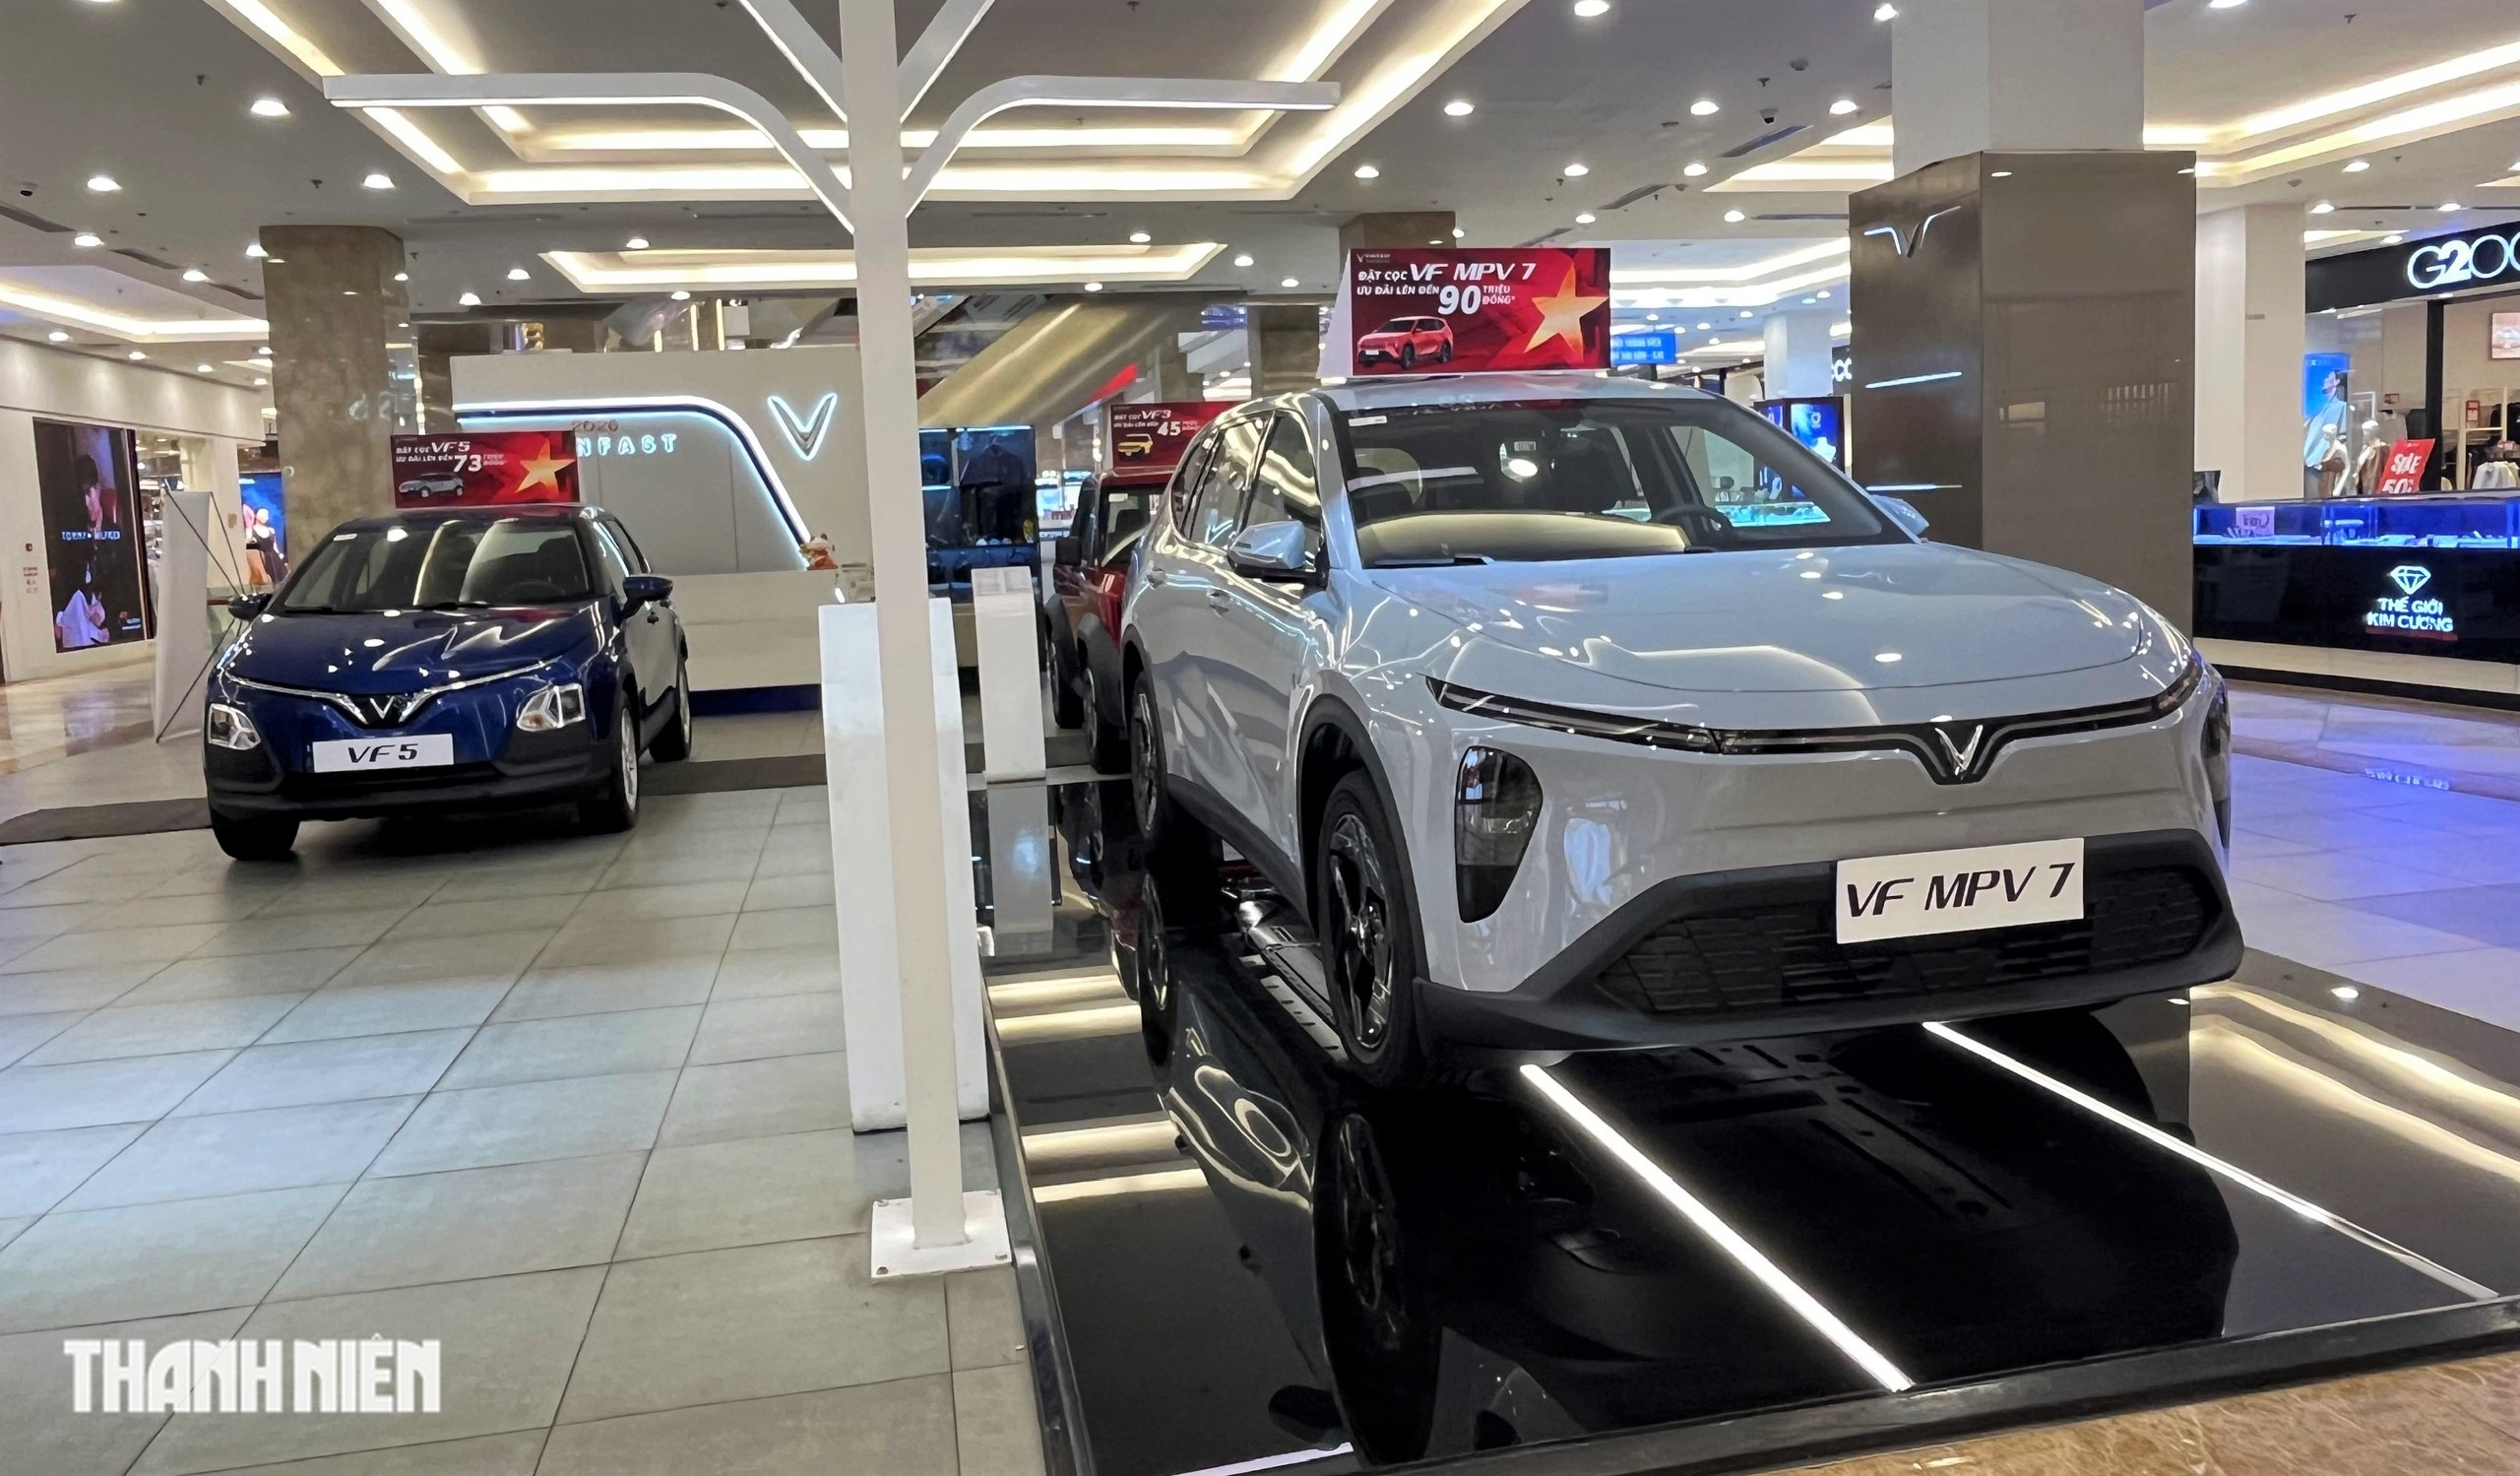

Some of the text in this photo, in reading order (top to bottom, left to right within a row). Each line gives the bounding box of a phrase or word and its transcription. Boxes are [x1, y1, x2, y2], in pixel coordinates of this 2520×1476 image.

[1410, 263, 1448, 281] VF
[1453, 263, 1515, 281] MPV
[1522, 263, 1537, 280] 7
[1437, 285, 1481, 315] 90
[1157, 420, 1181, 436] 45
[575, 433, 677, 457] NFAST
[454, 455, 482, 473] 73
[2365, 611, 2395, 627] KIM
[347, 743, 418, 764] VF 5
[1847, 863, 2075, 918] VF MPV 7
